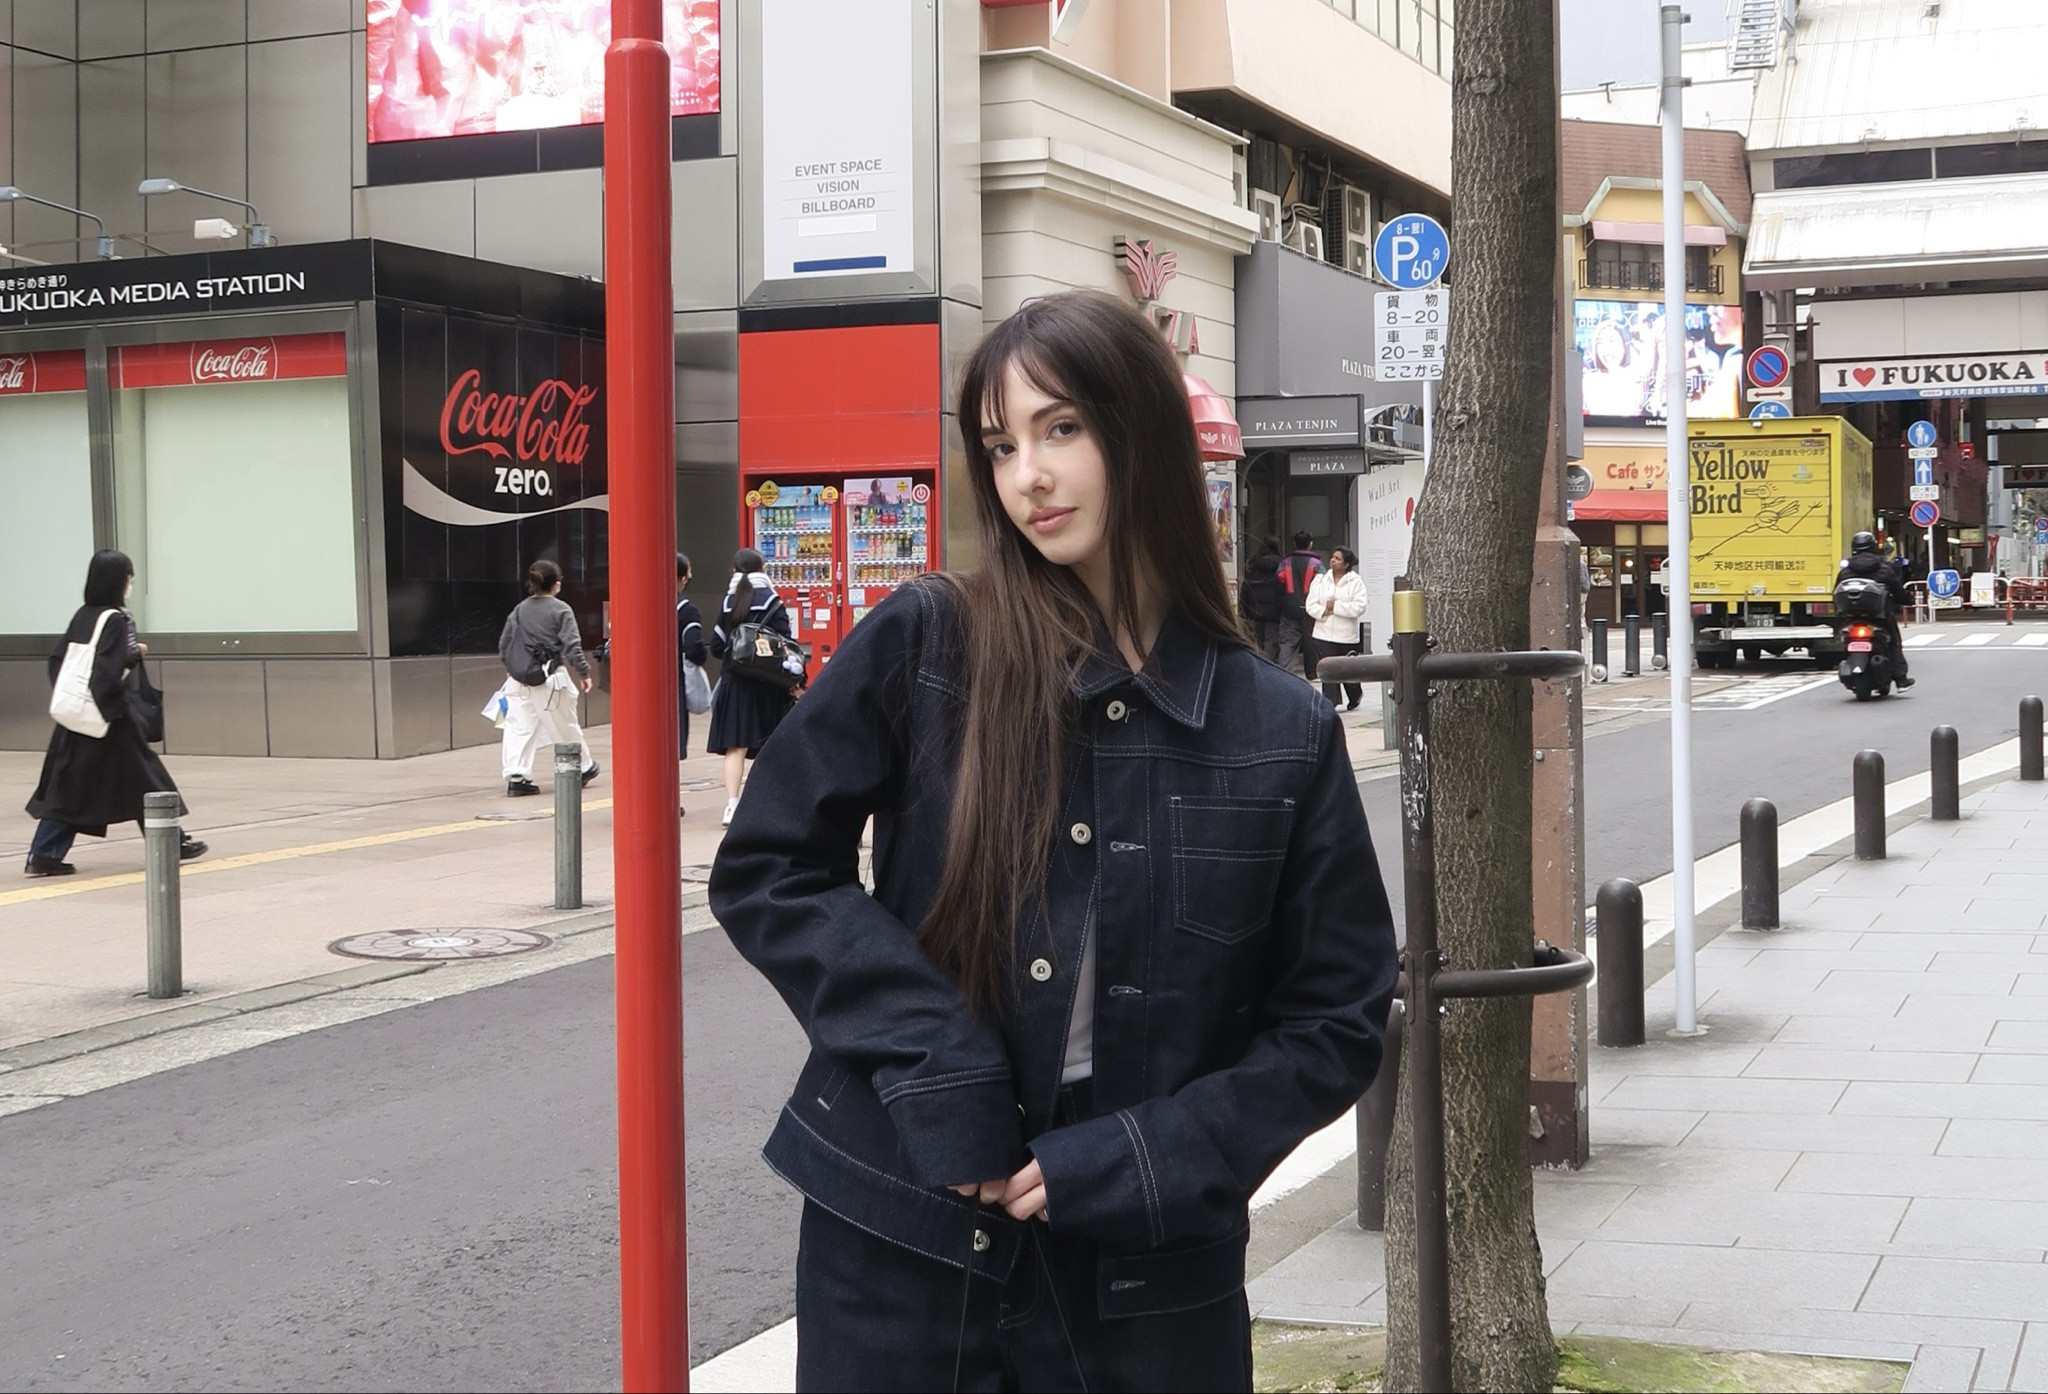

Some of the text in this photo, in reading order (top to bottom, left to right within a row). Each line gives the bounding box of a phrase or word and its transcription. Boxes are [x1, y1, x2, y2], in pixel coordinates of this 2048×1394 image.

[795, 159, 882, 177] EVENT SPACE
[817, 180, 860, 193] VISION
[801, 197, 875, 213] BILLBOARD
[1392, 235, 1420, 281] P
[1411, 259, 1432, 281] 60
[110, 282, 190, 305] MEDIA
[196, 272, 305, 298] STATION
[195, 346, 271, 380] Coca-Cola
[1342, 358, 1362, 377] PLAZA
[1384, 364, 1443, 379] ここから
[1837, 369, 1848, 388] I
[1882, 361, 2035, 386] FUKUOKA
[440, 368, 598, 465] Coca-Cola
[1256, 418, 1339, 431] PLAZA TENJIN
[1310, 462, 1345, 472] PLAZA
[1606, 462, 1639, 480] Café
[1692, 449, 1770, 480] Yellow
[1692, 482, 1742, 515] Bird
[1369, 507, 1398, 531] Project
